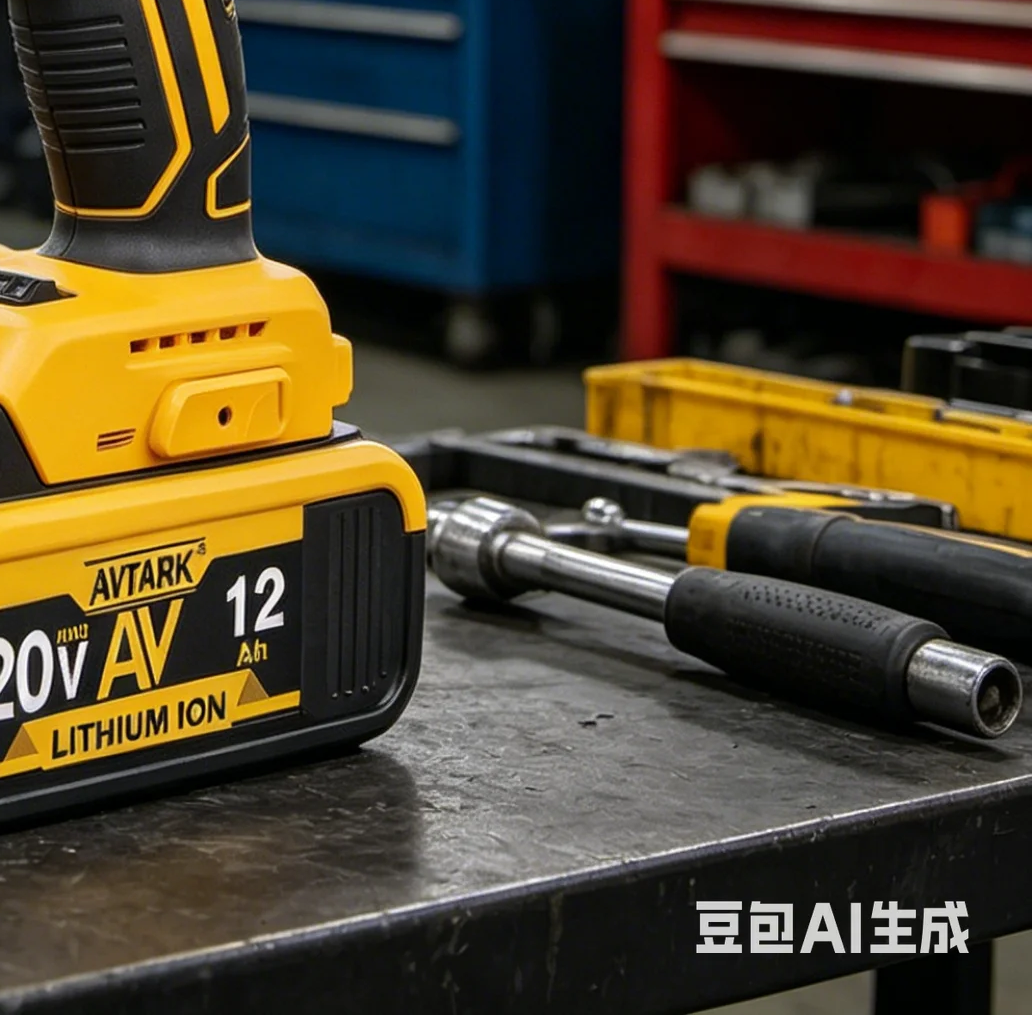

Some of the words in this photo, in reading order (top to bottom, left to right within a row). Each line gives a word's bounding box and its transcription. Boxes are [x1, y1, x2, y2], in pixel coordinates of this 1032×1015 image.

[89, 549, 194, 606] AVTARK
[226, 566, 285, 637] 12
[97, 598, 185, 701] AV
[51, 705, 168, 760] LITHIUM
[178, 691, 226, 729] ION
